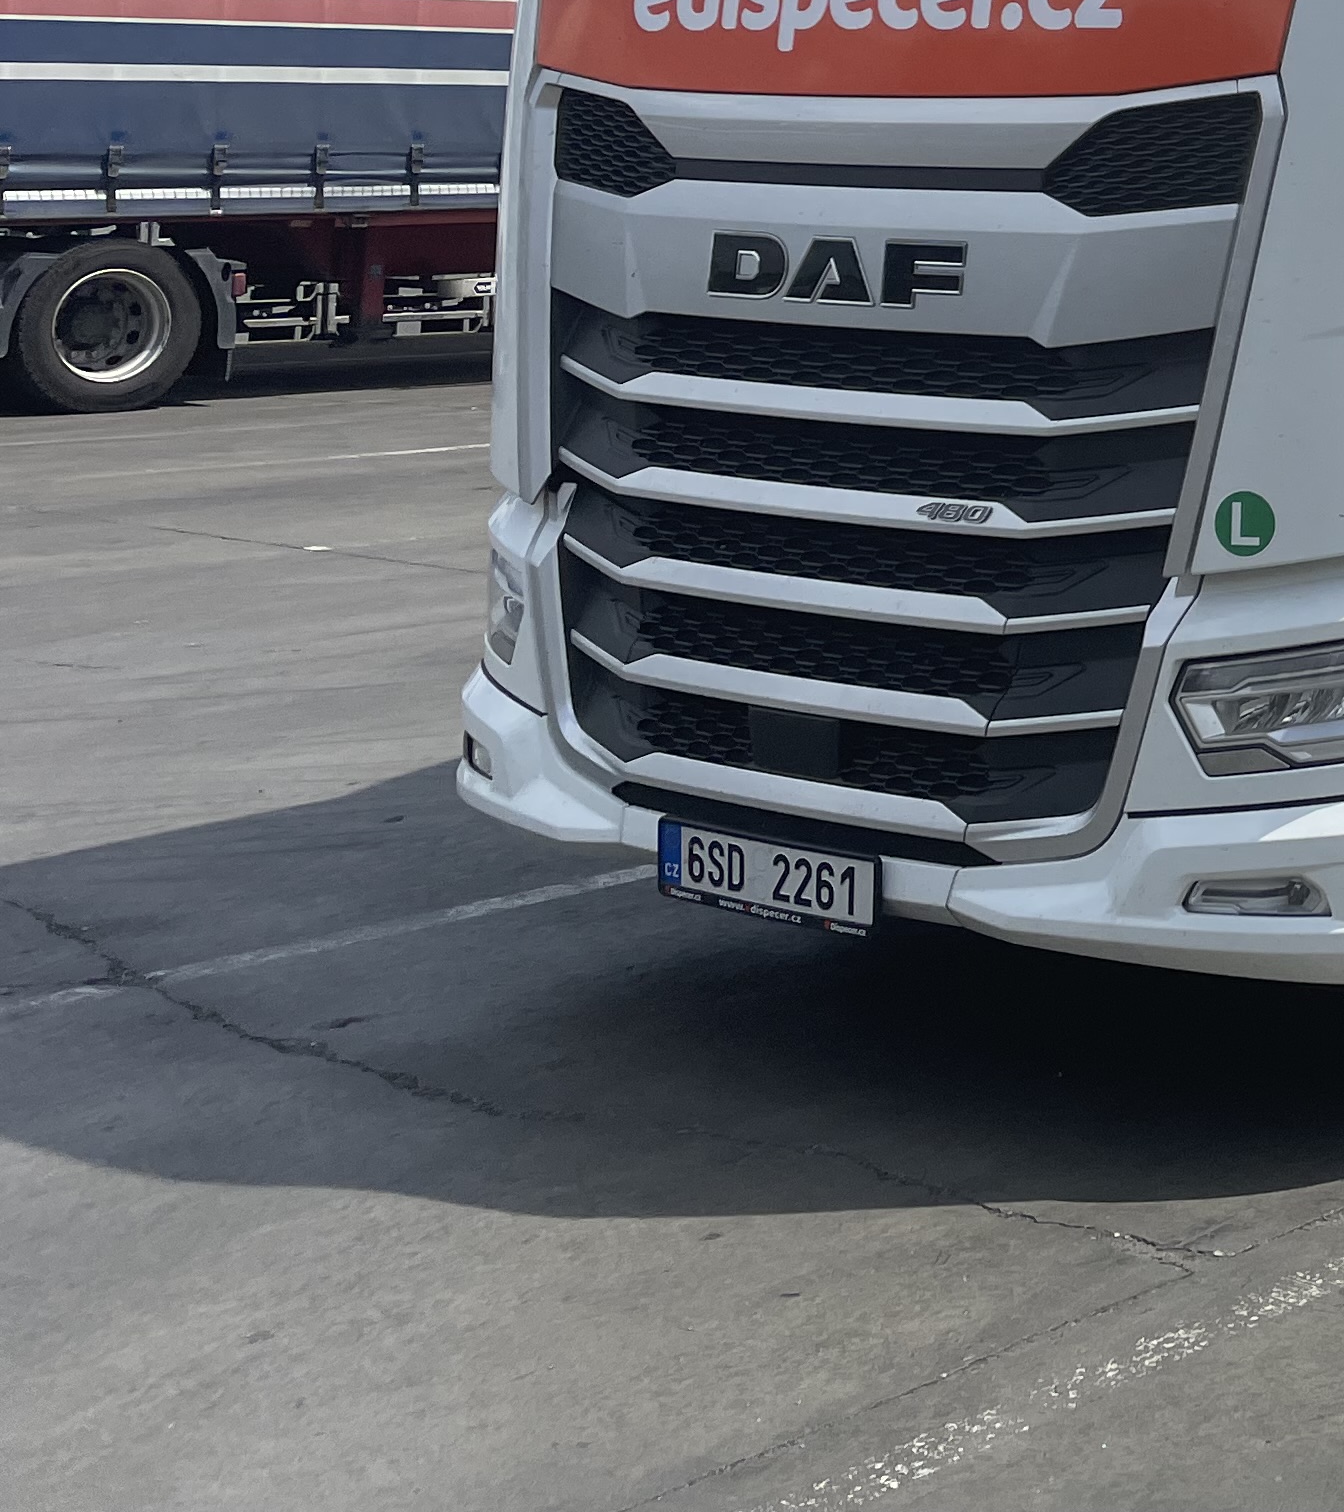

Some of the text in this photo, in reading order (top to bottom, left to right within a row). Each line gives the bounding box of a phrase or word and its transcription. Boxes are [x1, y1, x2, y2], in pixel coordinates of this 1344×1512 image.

[706, 229, 968, 309] DAF
[916, 502, 993, 524] 480
[1231, 501, 1260, 546] L
[664, 861, 680, 878] CZ
[687, 836, 855, 916] 6SD 2261
